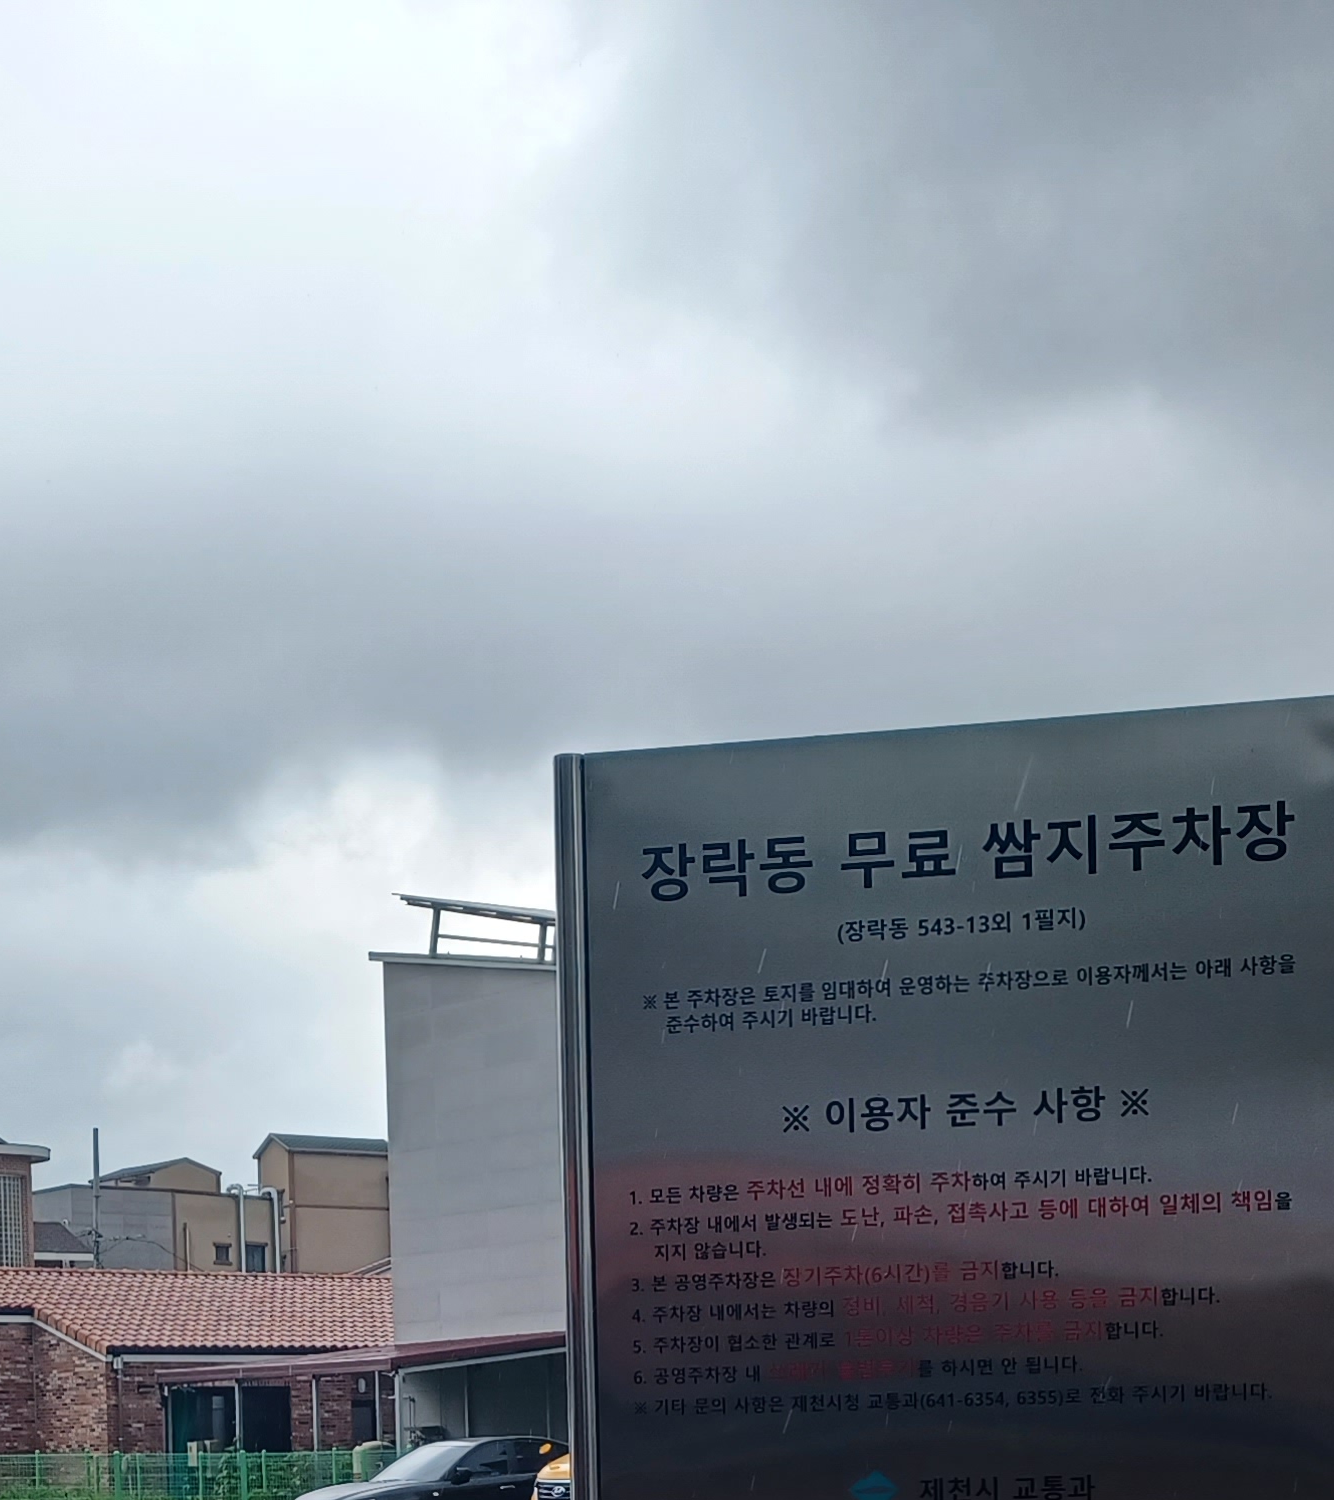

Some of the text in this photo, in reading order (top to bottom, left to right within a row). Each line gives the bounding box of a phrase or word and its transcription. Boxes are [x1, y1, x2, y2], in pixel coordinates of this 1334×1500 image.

[639, 799, 1298, 904] 장락동 무료 쌈지주차장
[836, 907, 1087, 946] (장락동 543-13외 1필지)
[664, 989, 679, 1011] 본
[685, 984, 757, 1010] 주차장은
[762, 980, 814, 1004] 토지를
[820, 975, 893, 1001] 임대하여
[898, 971, 970, 997] 운영하는
[976, 965, 1069, 993] 주차장으로
[1076, 959, 1188, 987] 이용자께서는
[1194, 956, 1233, 981] 아래
[1240, 953, 1296, 978] 사항을
[665, 1002, 878, 1036] 준수하여 주시기 바랍니다.
[824, 1093, 932, 1134] 이용자
[945, 1091, 1018, 1129] 준수
[1032, 1085, 1107, 1126] 사항
[629, 1165, 1153, 1206] 1. 모든 차량은 주차선 내에 정확히 주차하여 주시기 바랍니다.
[629, 1188, 1293, 1237] 2. 주차장 내에서 발생되는 도난, 파손, 접촉사고 등에 대하여 일체의 책임을
[654, 1240, 767, 1262] 지지 않습니다.
[631, 1278, 645, 1293] 3.
[651, 1274, 668, 1292] 본
[674, 1268, 777, 1291] 공영주차장은
[959, 1259, 1060, 1281] 금지합니다.
[631, 1309, 646, 1323] 4.
[652, 1303, 703, 1323] 주차장
[709, 1300, 777, 1322] 내에서는
[784, 1299, 836, 1319] 차량의
[950, 1290, 1010, 1313] 경음기
[1020, 1288, 1059, 1310] 사용
[1068, 1288, 1109, 1309] 등을
[1118, 1285, 1221, 1307] 금지합니다.
[633, 1340, 646, 1354] 5.
[653, 1334, 720, 1354] 주차장이
[727, 1333, 778, 1352] 협소한
[785, 1331, 836, 1350] 관계로
[923, 1324, 985, 1345] 차량은
[1064, 1319, 1164, 1341] 금지합니다.
[633, 1370, 647, 1385] 6.
[653, 1365, 738, 1385] 공영주차장
[745, 1364, 761, 1383] 내
[941, 1358, 993, 1377] 하시면
[1001, 1357, 1018, 1374] 안
[1025, 1354, 1083, 1373] 됩니다.
[654, 1397, 686, 1416] 기타
[694, 1397, 727, 1415] 문의
[734, 1395, 784, 1414] 사항은
[791, 1391, 860, 1413] 제천시청
[867, 1387, 1010, 1412] 교통과(641-6354,
[1017, 1387, 1083, 1407] 6355)로
[1090, 1385, 1125, 1405] 전화
[1131, 1384, 1186, 1404] 주시기
[1194, 1381, 1273, 1402] 바랍니다.
